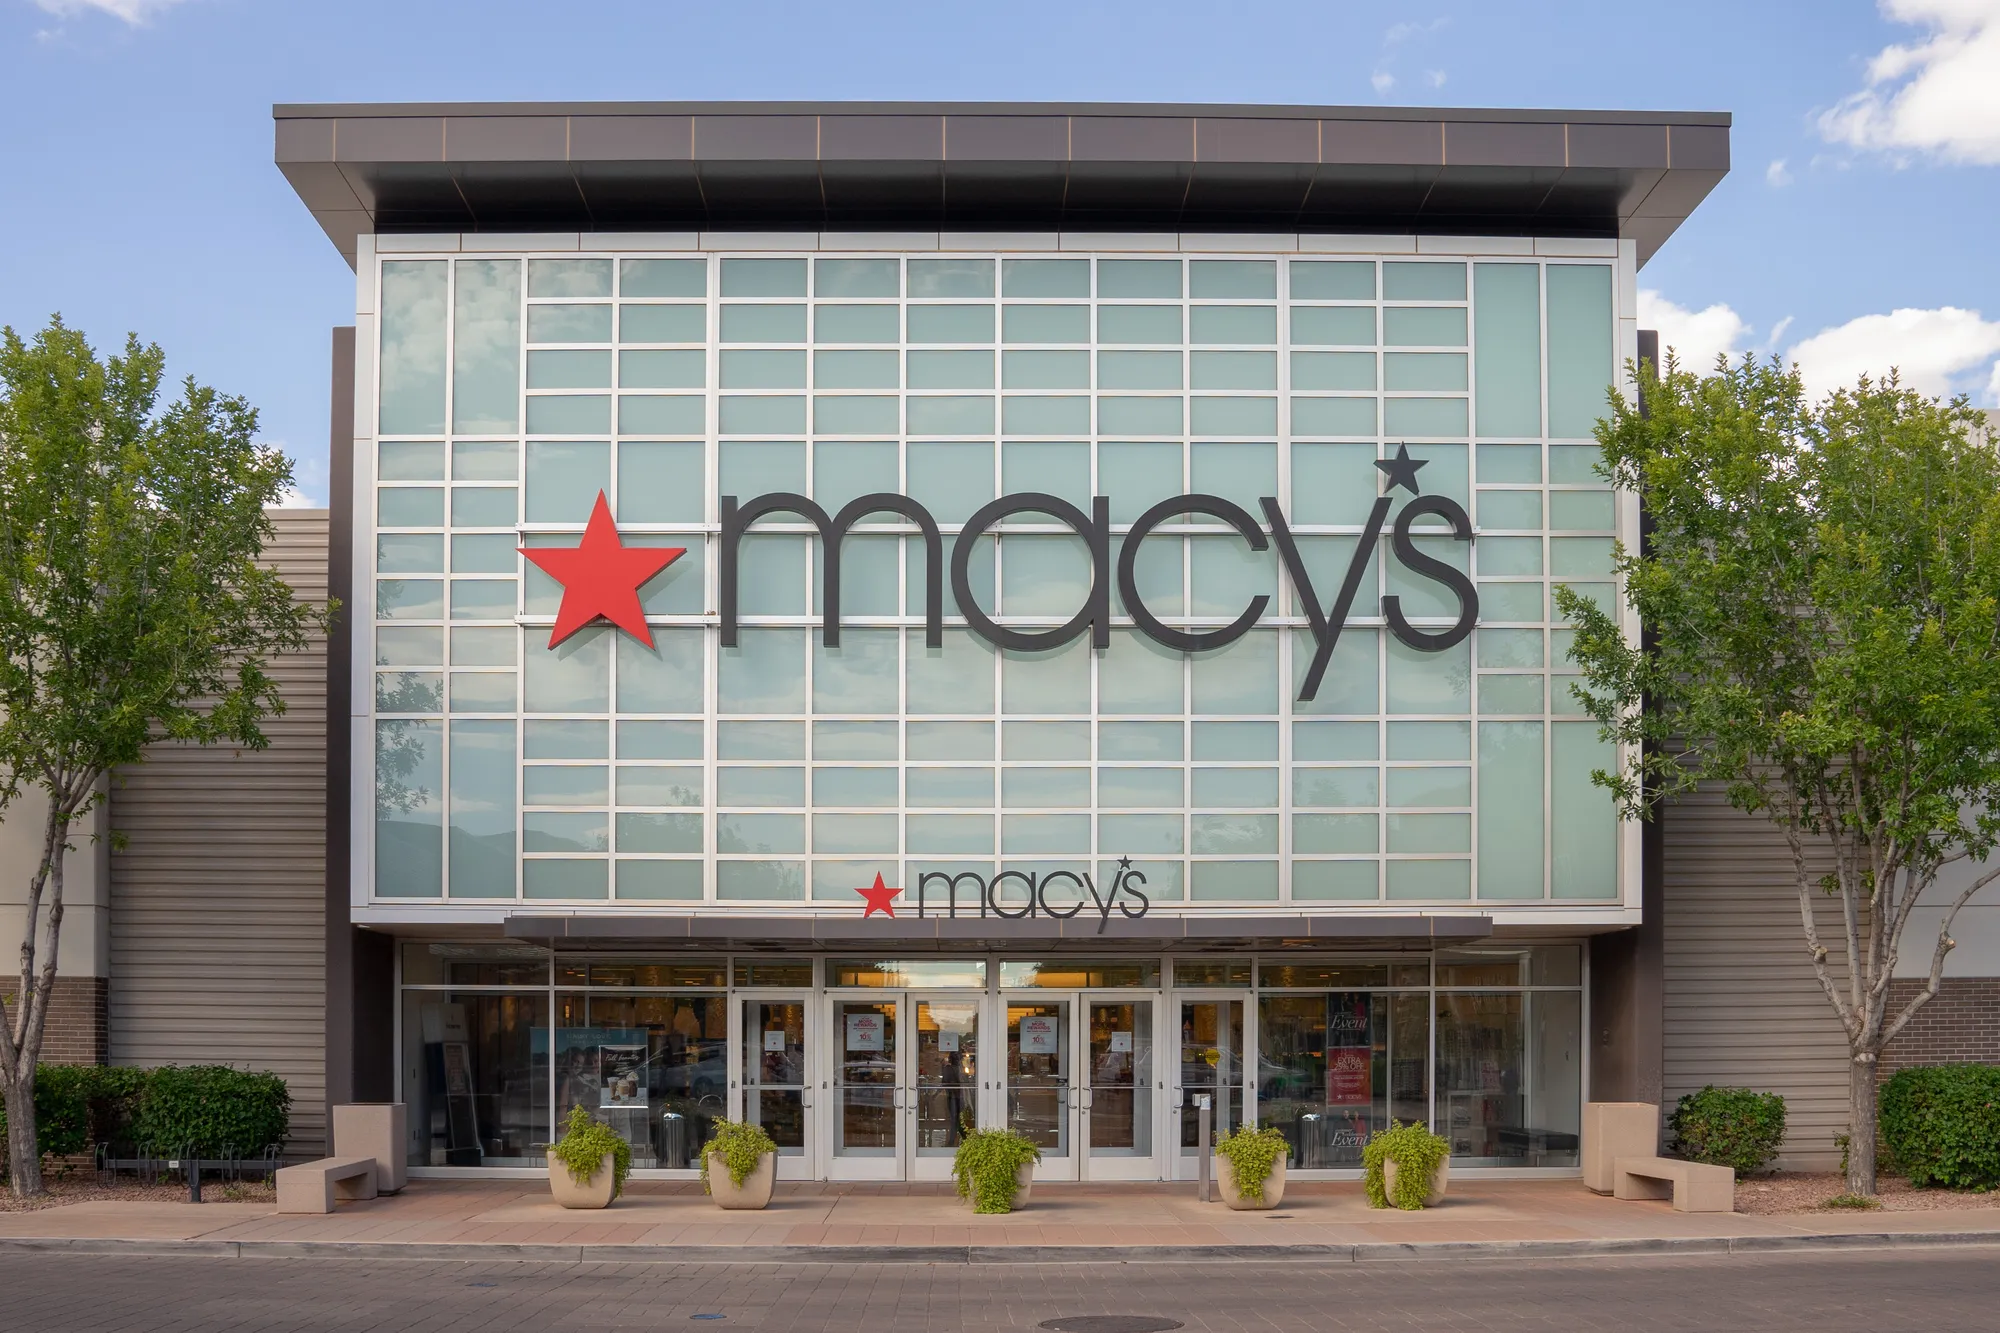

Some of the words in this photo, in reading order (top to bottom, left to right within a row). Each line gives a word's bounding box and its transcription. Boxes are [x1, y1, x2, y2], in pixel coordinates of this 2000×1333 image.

[1330, 1014, 1368, 1029] Event
[1337, 1056, 1362, 1064] EXTRA
[1331, 1132, 1368, 1146] Event
